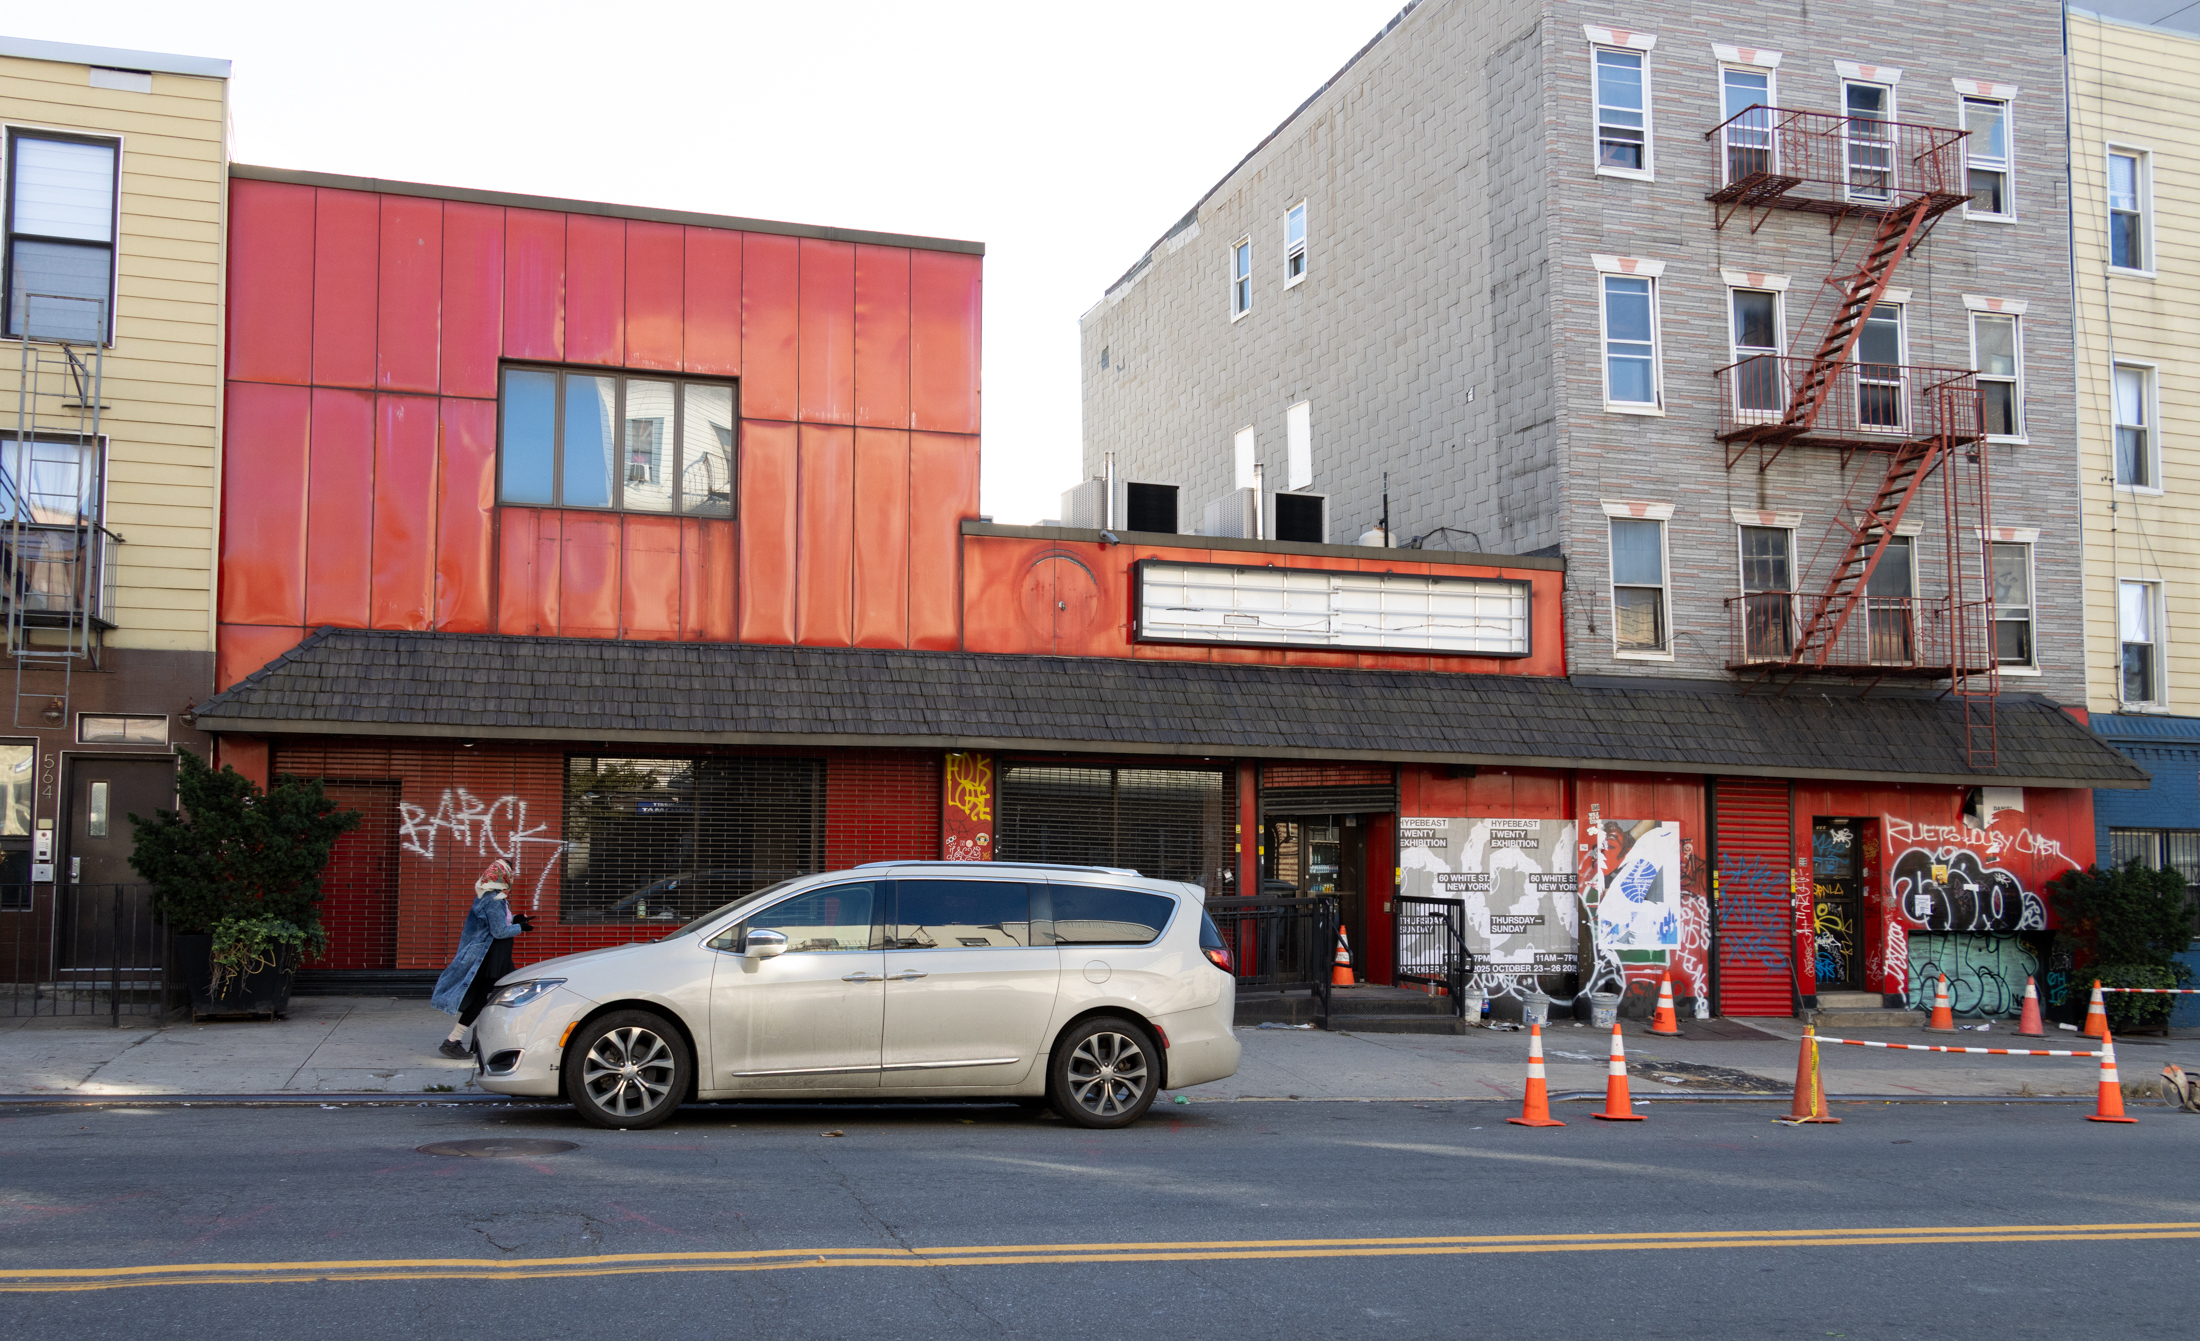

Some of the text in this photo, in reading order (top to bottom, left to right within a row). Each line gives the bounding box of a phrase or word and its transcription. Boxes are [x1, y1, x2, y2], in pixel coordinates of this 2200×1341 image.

[42, 754, 55, 799] 564
[1400, 819, 1447, 828] HYPEBEAST
[1491, 820, 1538, 828] HYPEBEAST
[1400, 829, 1434, 838] TWENTY
[1491, 830, 1526, 838] TWENTY
[1400, 838, 1446, 847] EXHIBITION
[1491, 839, 1538, 847] EXHIBITION
[1438, 874, 1490, 882] 60 WHITE ST.
[1530, 874, 1540, 883] 60
[1541, 875, 1568, 883] WHITE
[1447, 883, 1490, 891] NEW YORK
[1538, 883, 1577, 891] NEW YORK
[1491, 925, 1525, 934] SUNDAY
[1492, 964, 1531, 973] OCTOBER
